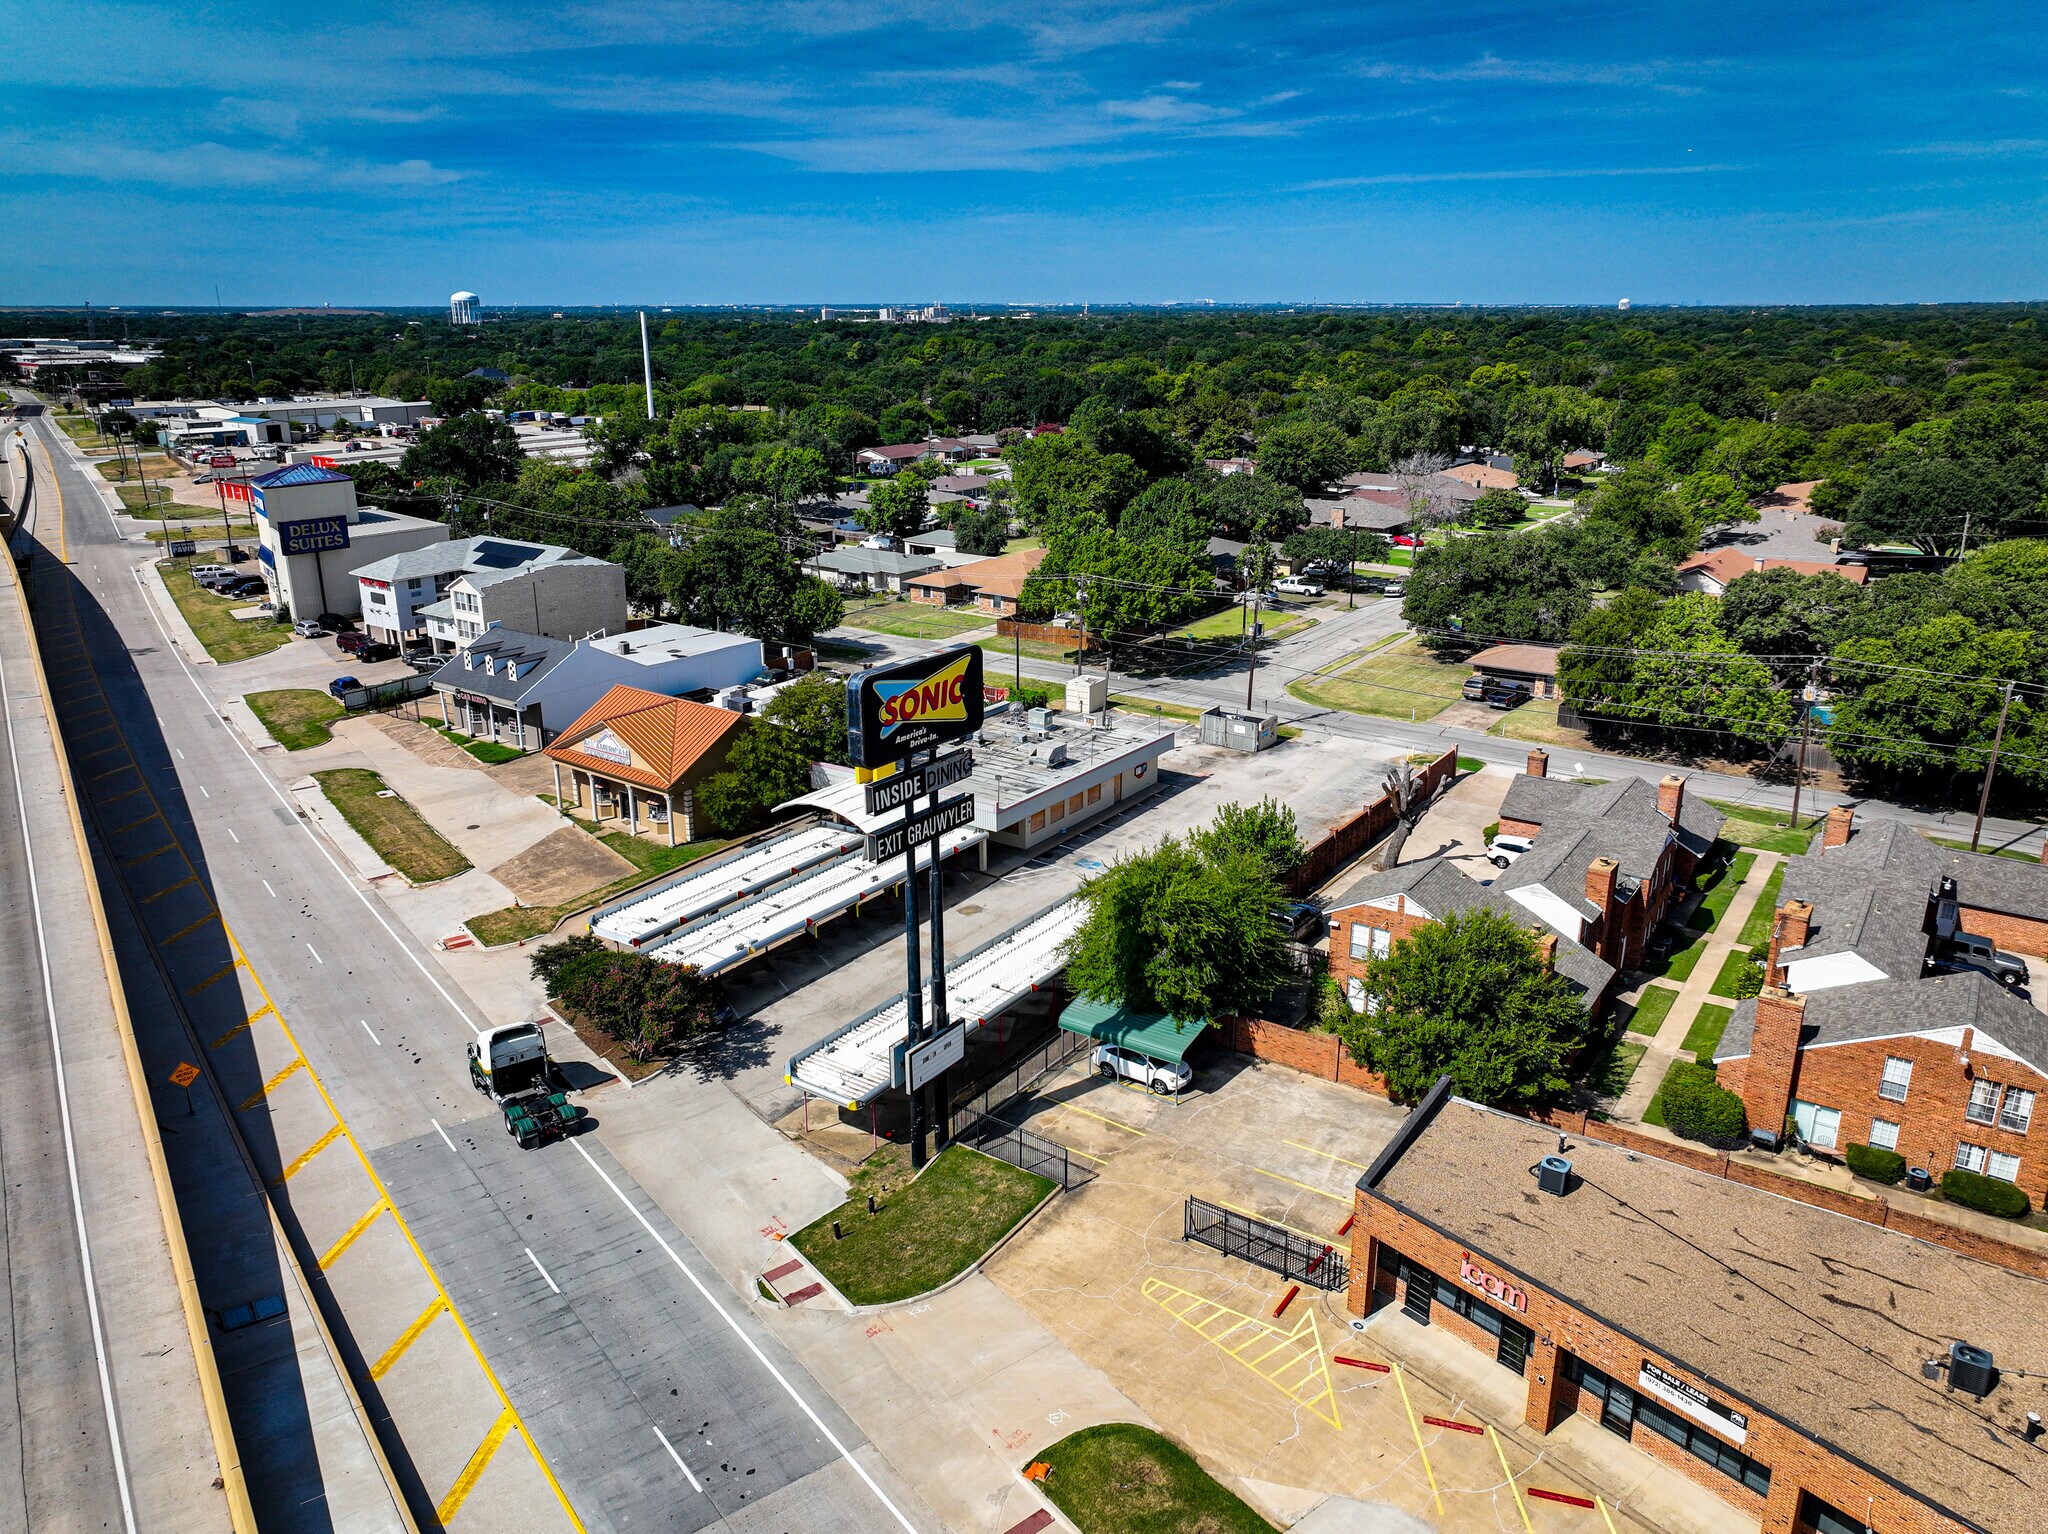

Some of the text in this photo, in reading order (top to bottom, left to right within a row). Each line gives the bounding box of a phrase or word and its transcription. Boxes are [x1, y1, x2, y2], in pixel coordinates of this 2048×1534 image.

[289, 521, 341, 537] DELUX
[172, 545, 196, 553] PAWN
[289, 534, 344, 551] SUITES
[883, 674, 964, 727] SONIC
[895, 726, 927, 744] America's
[875, 756, 972, 811] INSIDE DINING
[878, 800, 973, 859] EXIT GRAUWYLER
[176, 1070, 194, 1079] MERGE
[178, 1075, 194, 1083] RIGHT
[1460, 1251, 1527, 1314] icom
[1645, 1375, 1661, 1389] (972)
[1646, 1363, 1662, 1376] FOR
[1662, 1372, 1681, 1387] SALE
[1686, 1386, 1709, 1404] LEASE
